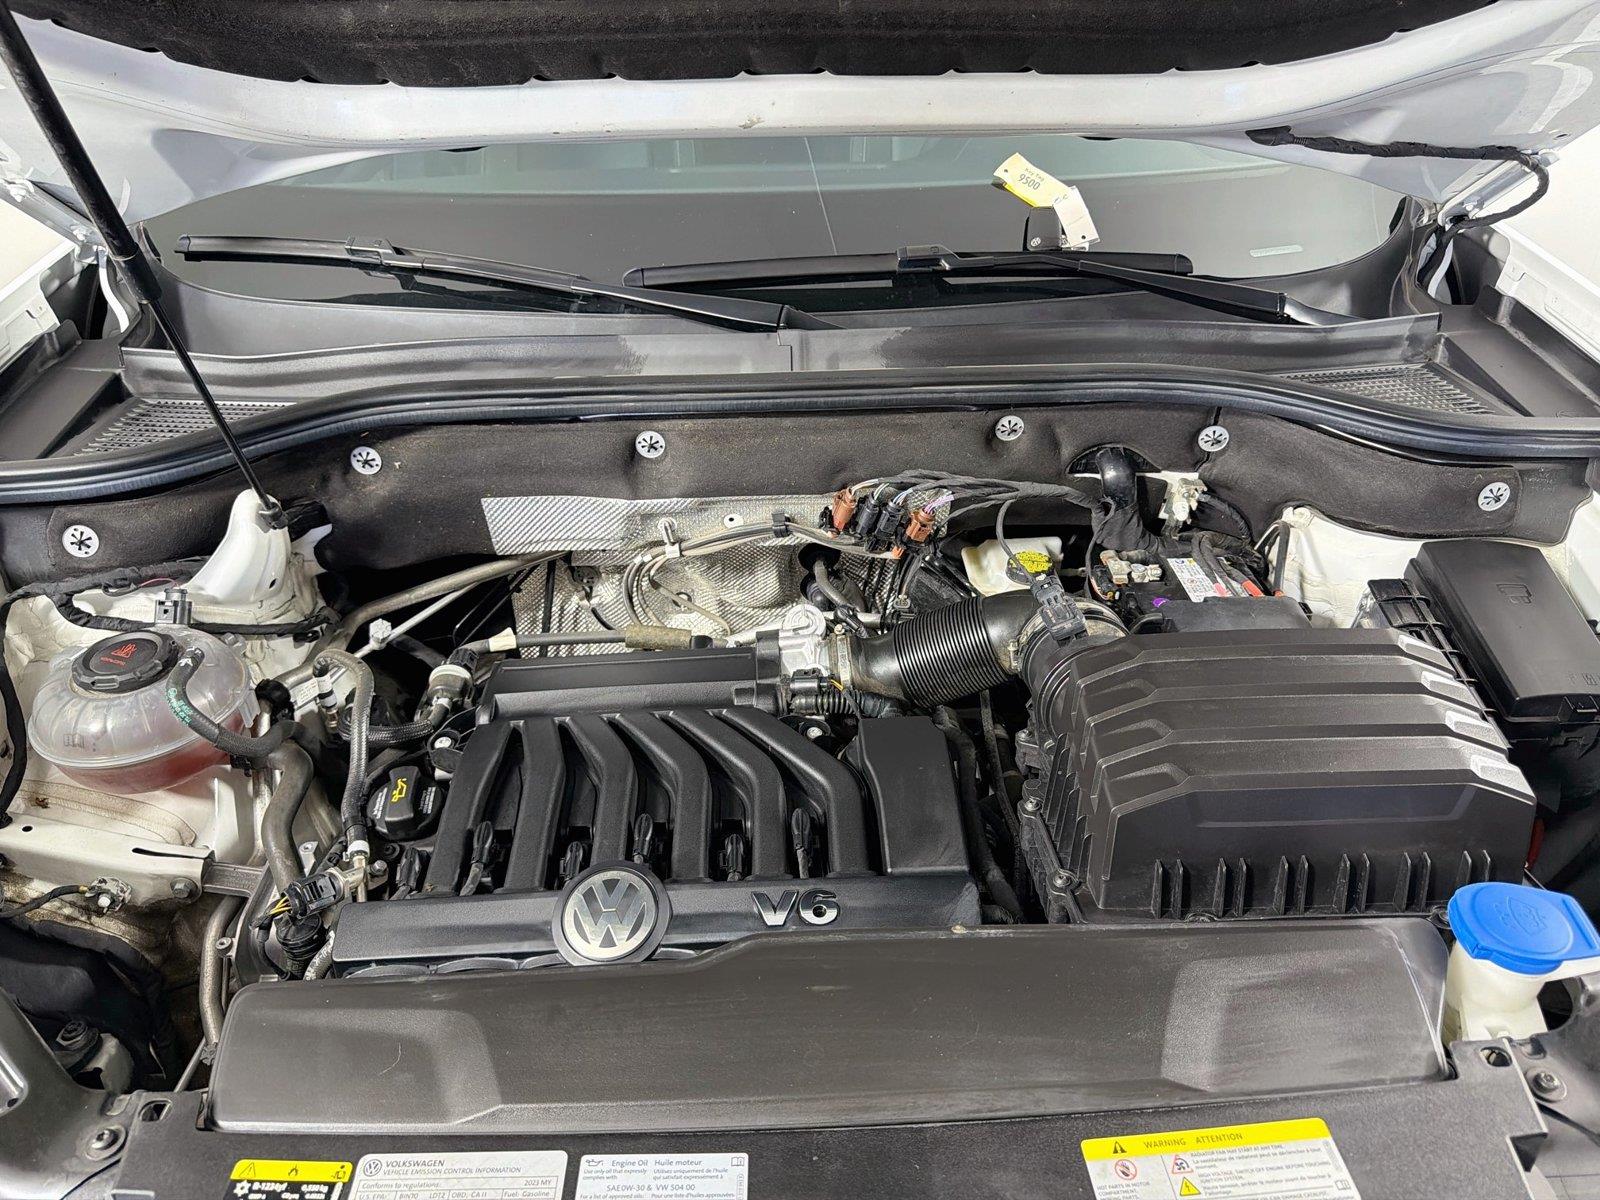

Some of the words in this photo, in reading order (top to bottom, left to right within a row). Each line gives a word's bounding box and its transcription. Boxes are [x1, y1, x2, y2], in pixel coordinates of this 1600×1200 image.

[1018, 173, 1041, 190] 9500
[752, 888, 840, 926] V6
[1144, 1138, 1186, 1149] WARNING
[1196, 1133, 1243, 1144] ATTENTION
[386, 1159, 445, 1168] VOLKSWAGEN
[611, 1159, 636, 1168] Engine
[637, 1159, 648, 1167] Oil
[522, 1190, 550, 1198] Gasoline
